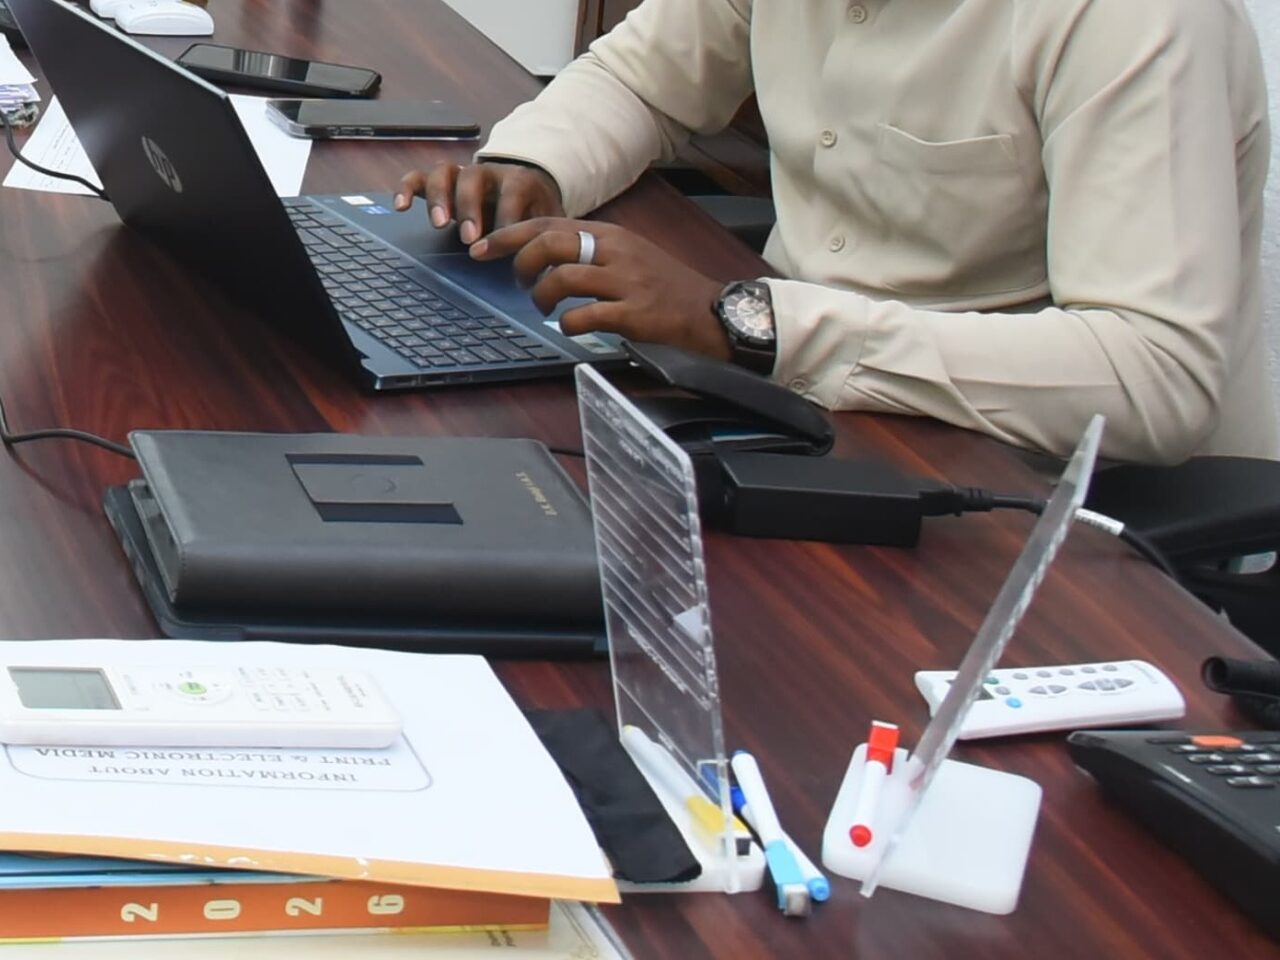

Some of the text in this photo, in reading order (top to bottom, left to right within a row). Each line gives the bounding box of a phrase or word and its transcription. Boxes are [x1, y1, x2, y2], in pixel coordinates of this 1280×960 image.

[34, 747, 392, 767] PRINT & ELECTRONIC MEDIA
[90, 765, 359, 782] INFORMATION ABOUT
